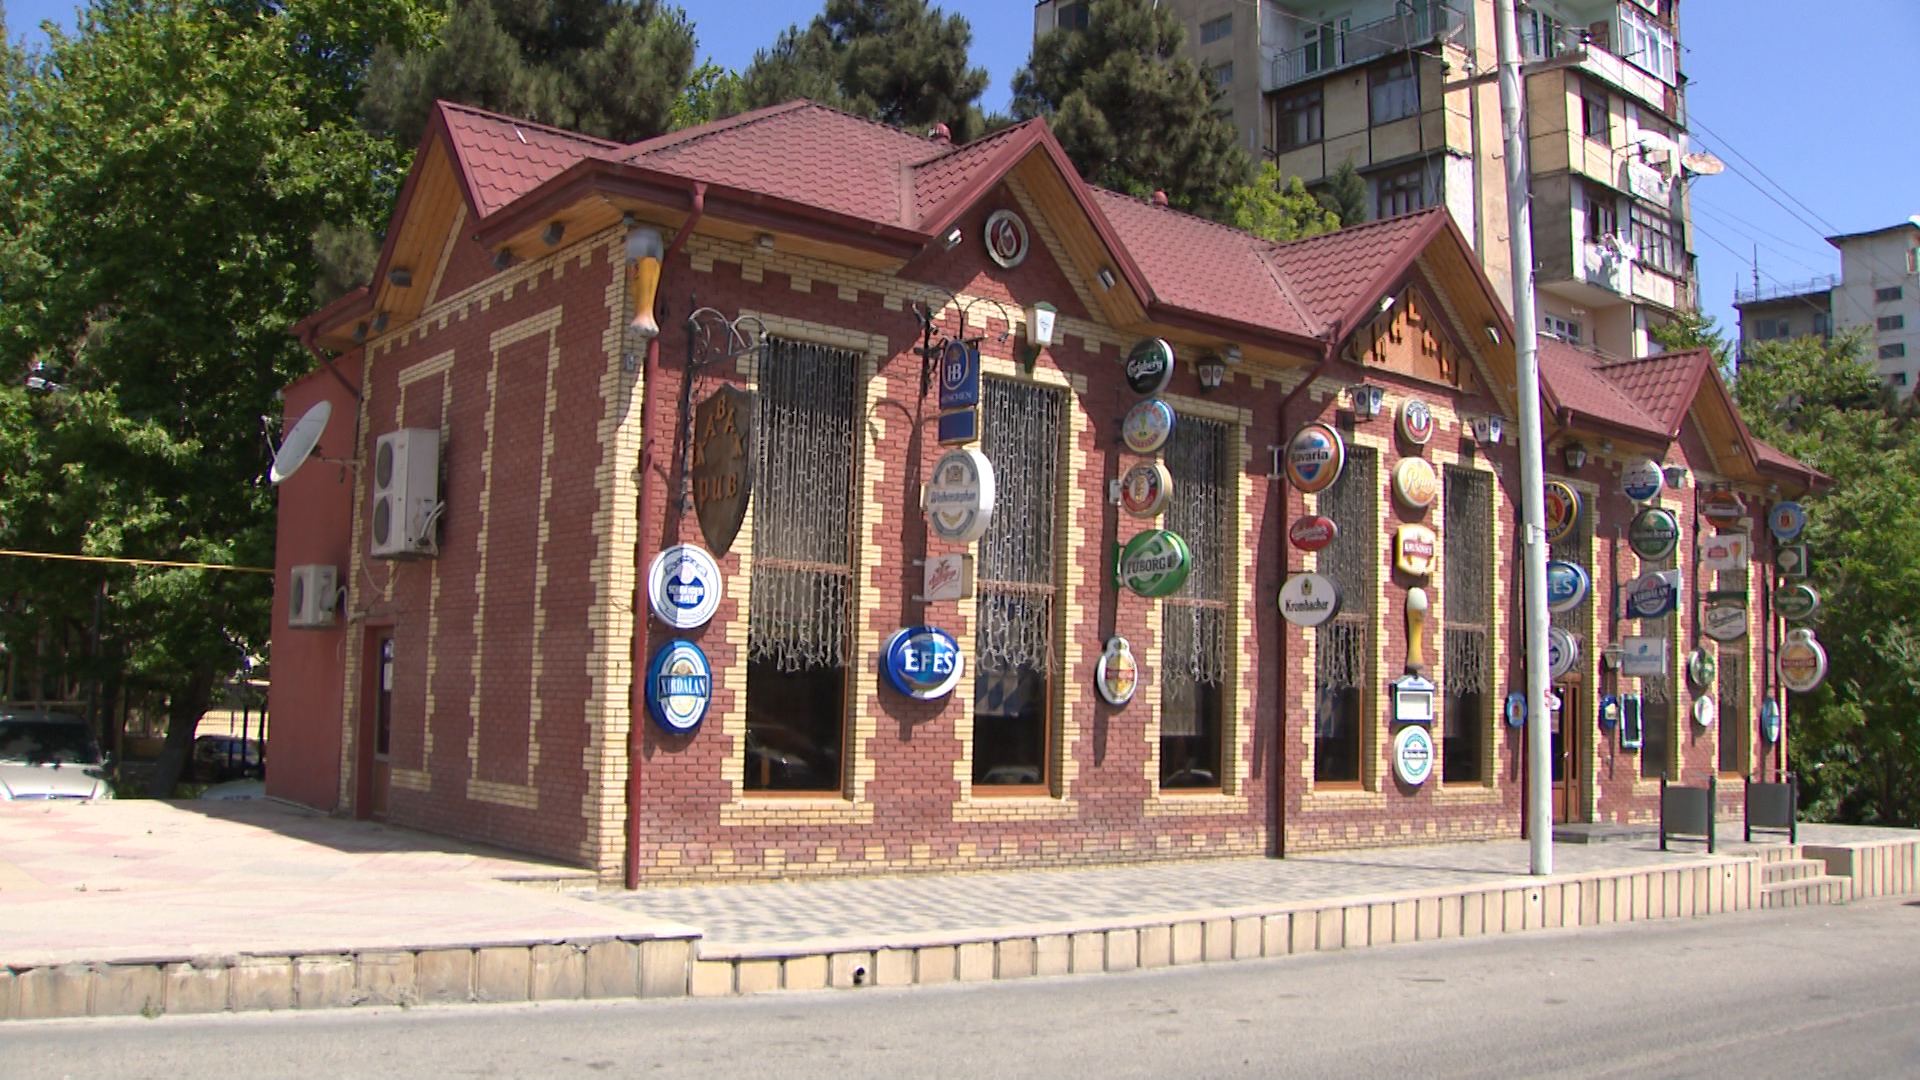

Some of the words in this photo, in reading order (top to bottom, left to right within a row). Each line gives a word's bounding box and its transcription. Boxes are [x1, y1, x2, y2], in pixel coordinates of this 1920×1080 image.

[1127, 359, 1164, 380] Carlsberg
[1290, 449, 1329, 463] avaria
[700, 472, 737, 505] PUB
[1127, 557, 1166, 573] TUBORG
[1553, 577, 1574, 595] ES
[1285, 597, 1328, 612] Krombacher
[904, 648, 954, 674] EFES
